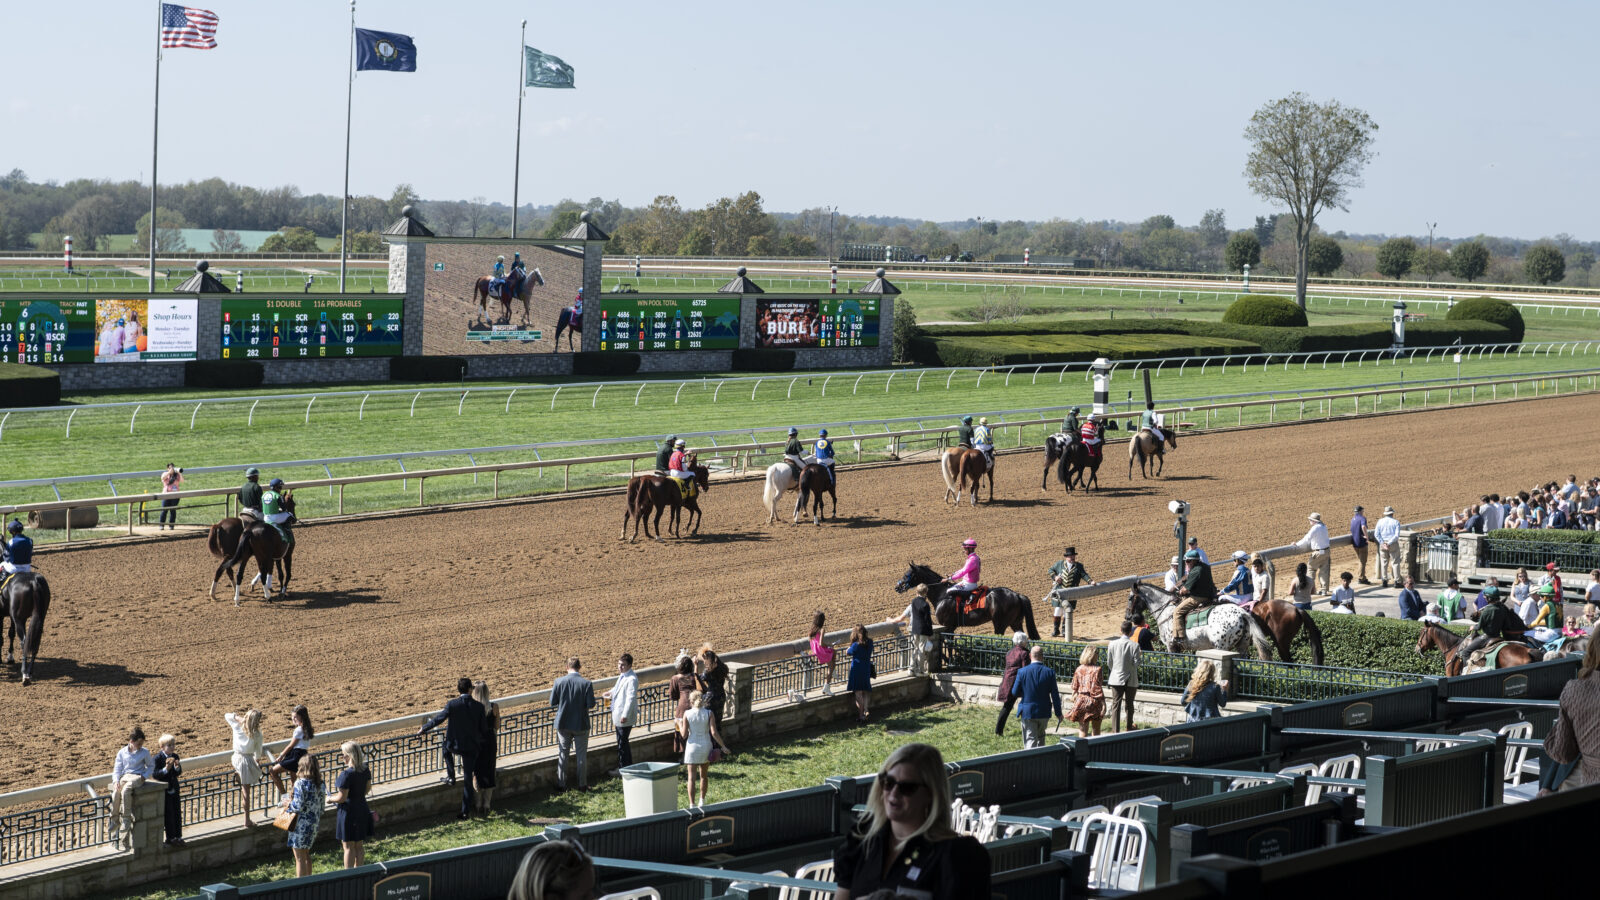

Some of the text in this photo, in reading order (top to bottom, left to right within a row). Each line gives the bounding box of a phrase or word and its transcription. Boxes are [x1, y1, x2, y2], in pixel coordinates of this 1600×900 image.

[266, 300, 274, 308] $1
[22, 308, 28, 318] 6
[252, 313, 260, 321] 15
[295, 313, 308, 321] SCR
[153, 313, 171, 322] Shop
[30, 323, 35, 331] 8
[54, 323, 64, 331] 16
[251, 325, 260, 333] 24
[274, 325, 278, 333] 6
[295, 325, 308, 333] SCR
[767, 321, 807, 335] BURL
[20, 333, 25, 341] 6
[30, 333, 35, 341] 7
[52, 333, 65, 341] SCR
[251, 337, 260, 345] 87
[300, 337, 308, 345] 45
[3, 344, 8, 352] 6
[56, 344, 61, 353] 3
[247, 349, 259, 357] 282
[300, 348, 307, 356] 12
[345, 347, 354, 355] 53
[3, 354, 8, 363] 3
